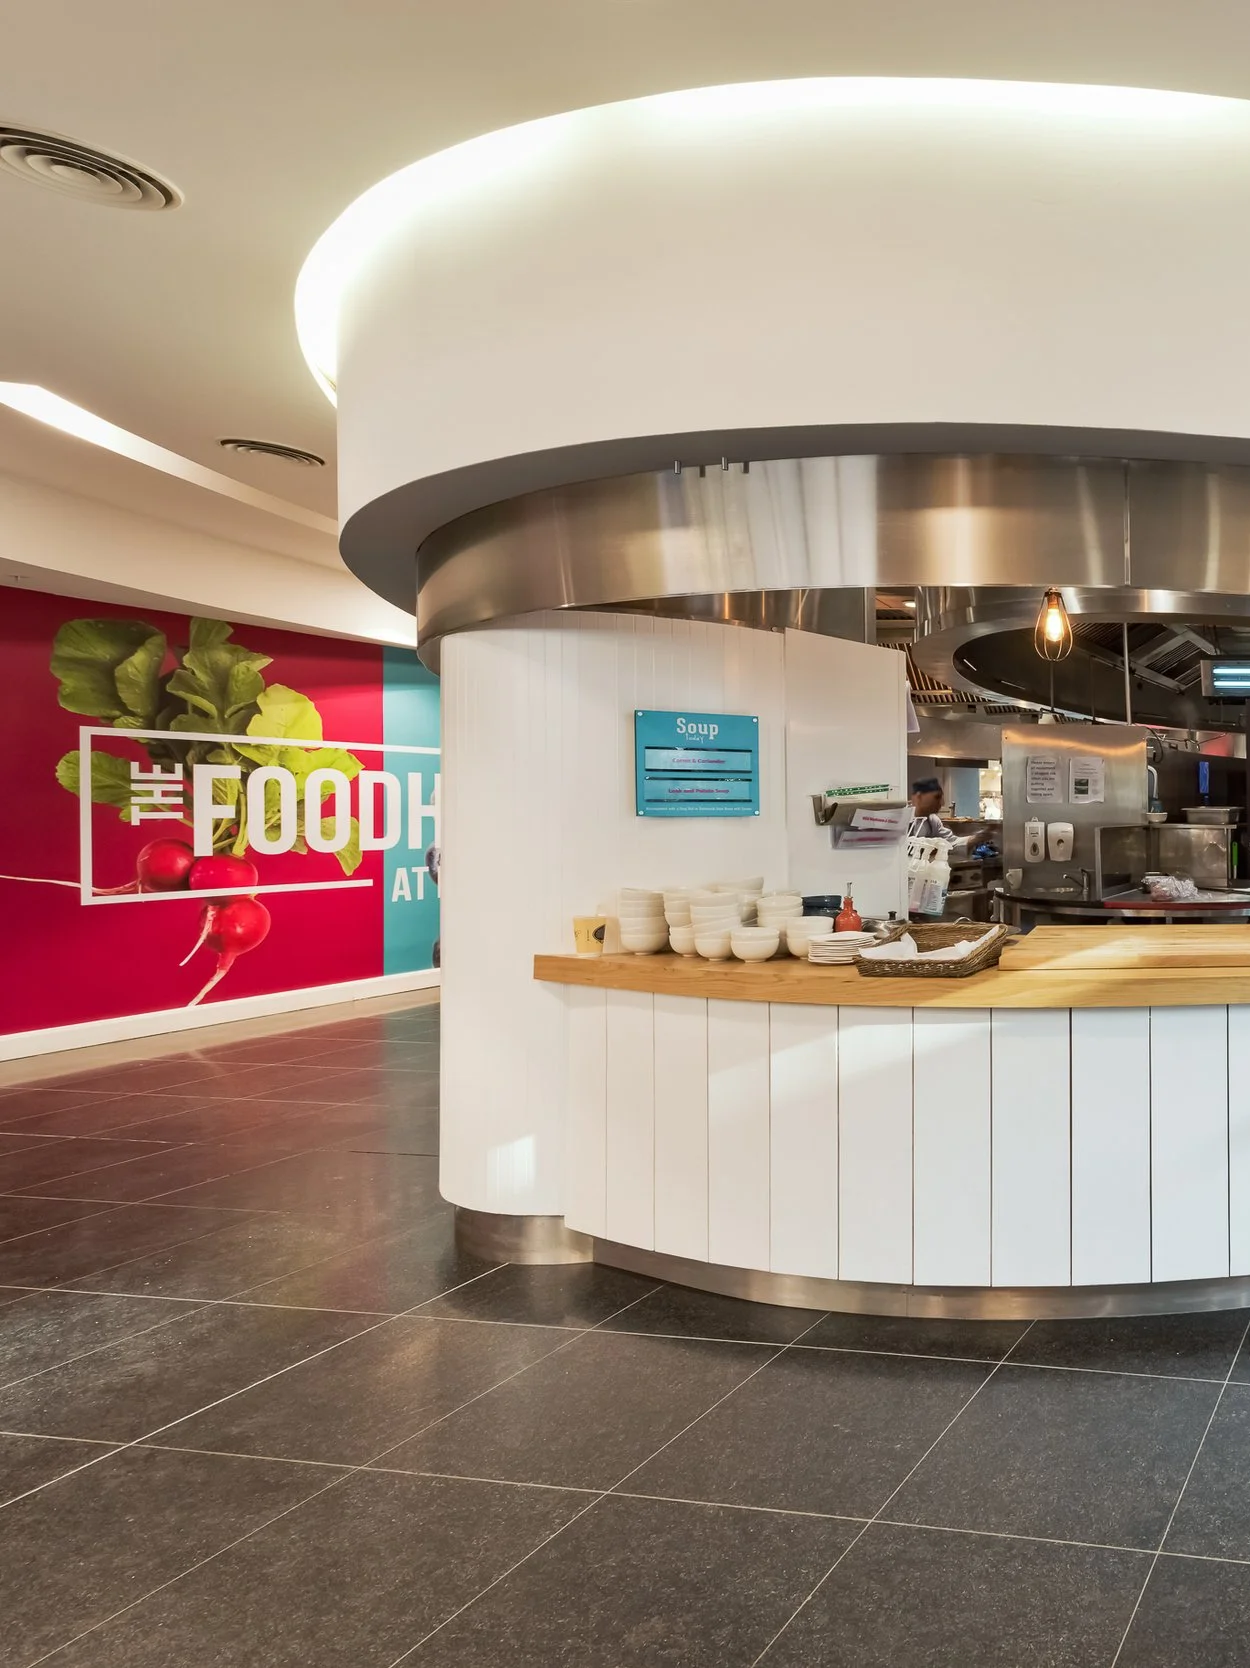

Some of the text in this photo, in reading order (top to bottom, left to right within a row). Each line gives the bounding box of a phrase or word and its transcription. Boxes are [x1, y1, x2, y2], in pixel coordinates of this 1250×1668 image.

[676, 717, 719, 740] Soup
[130, 761, 184, 826] THE
[391, 867, 430, 903] AT
